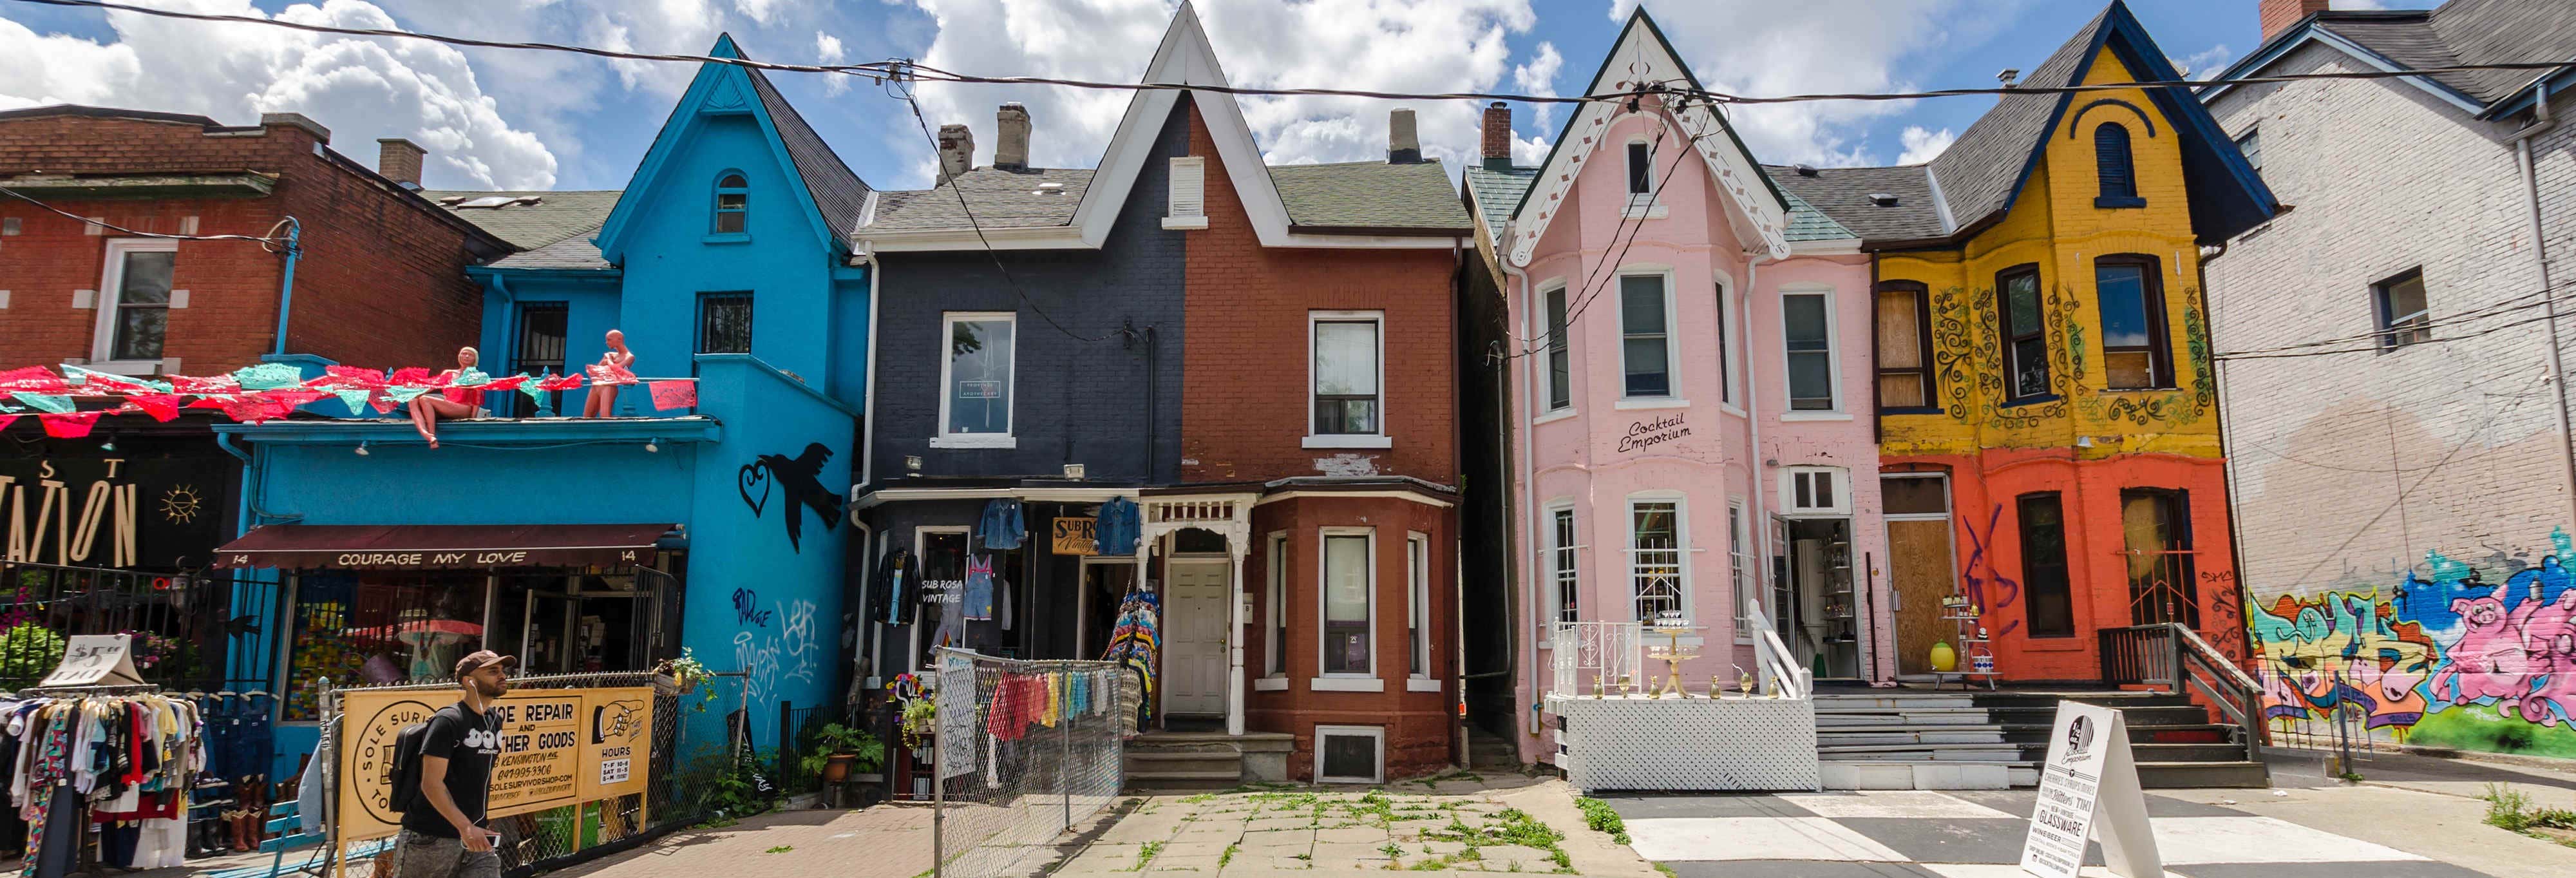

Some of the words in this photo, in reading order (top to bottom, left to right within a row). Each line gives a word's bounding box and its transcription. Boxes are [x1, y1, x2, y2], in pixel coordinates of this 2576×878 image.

[1629, 412, 1685, 436] Cocktail
[1618, 427, 1692, 453] Emporium
[232, 555, 249, 564] 14
[338, 553, 422, 566] COURAGE
[433, 553, 466, 564] MY
[477, 551, 527, 564] LOVE
[621, 550, 636, 561] 14
[922, 580, 939, 589] SUB
[940, 580, 963, 590] ROSA
[922, 593, 961, 604] VINTAGE
[494, 705, 516, 722] OE
[526, 703, 573, 721] REPAIR
[363, 724, 386, 771] SOLE
[502, 734, 530, 753] HER
[538, 731, 576, 750] GOODS
[501, 752, 547, 767] KENSINGTON
[602, 747, 630, 758] HOURS
[2076, 797, 2092, 812] TIKI
[2039, 809, 2082, 837] GLASSWARE
